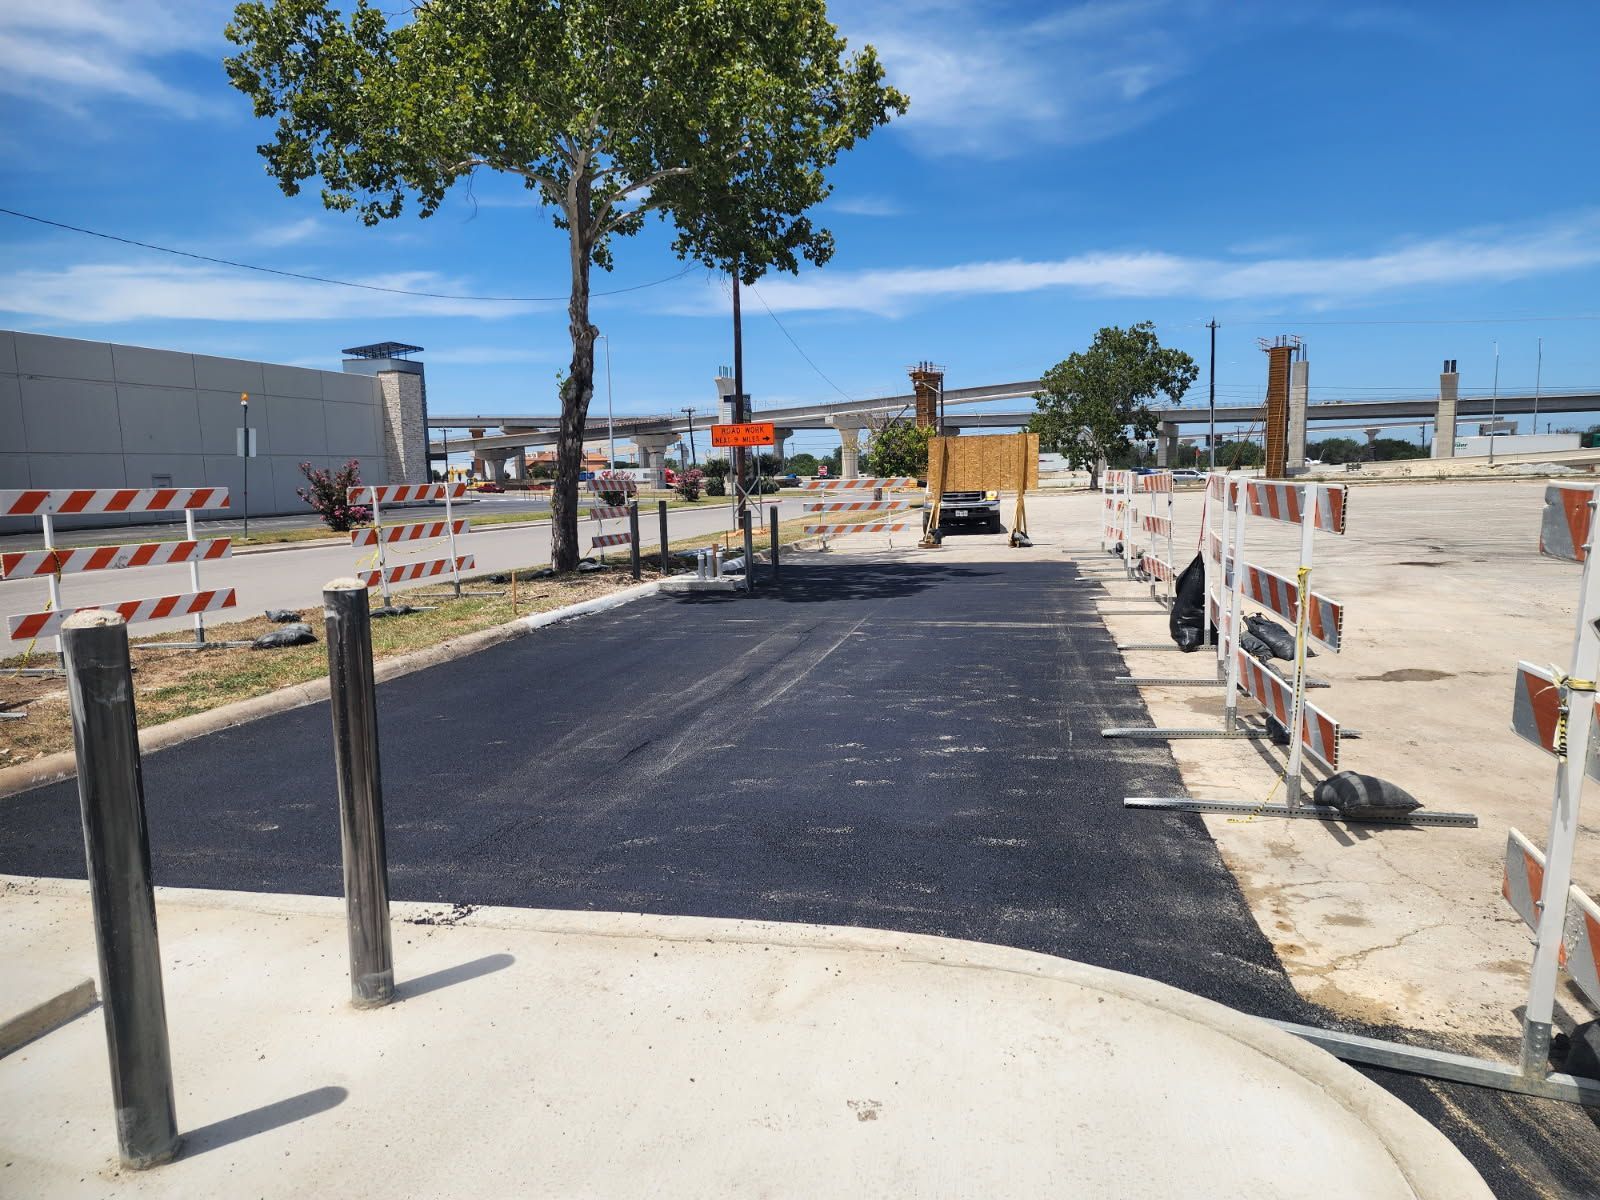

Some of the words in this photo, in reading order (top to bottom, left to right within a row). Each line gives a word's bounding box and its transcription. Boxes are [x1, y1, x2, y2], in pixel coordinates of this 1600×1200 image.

[721, 427, 741, 435] ROAD
[745, 426, 764, 434] WORK
[742, 435, 760, 443] MILES
